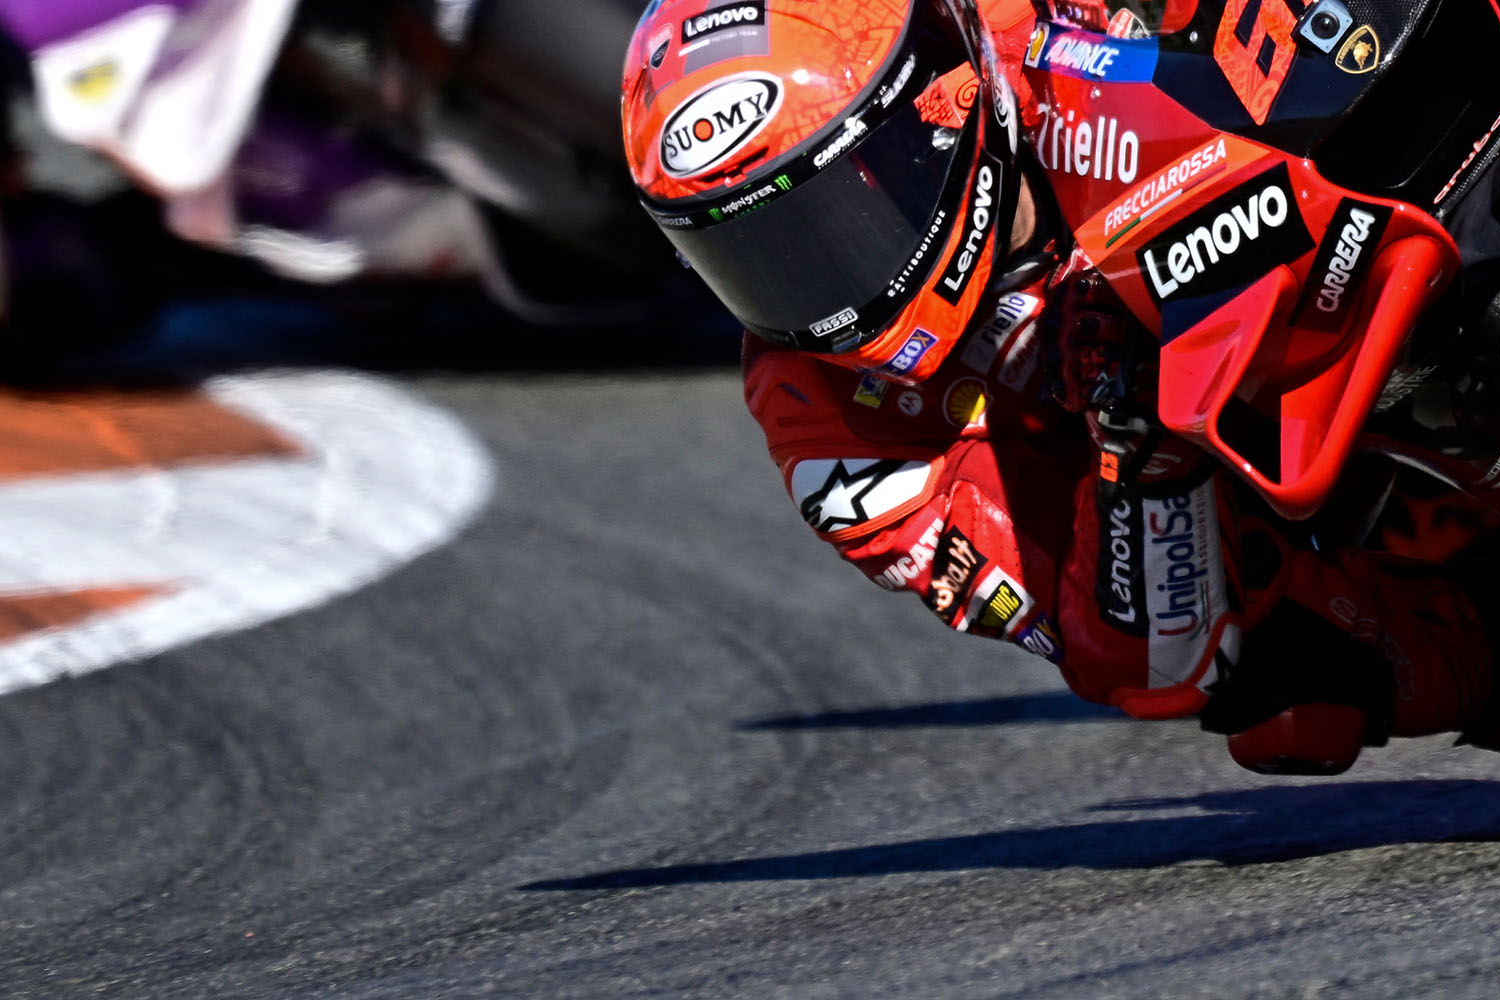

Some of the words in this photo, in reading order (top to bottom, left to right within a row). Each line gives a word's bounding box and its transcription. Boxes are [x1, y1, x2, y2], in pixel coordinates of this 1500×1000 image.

[684, 6, 758, 37] Lenovo
[1044, 36, 1120, 77] ADVANCE
[664, 92, 765, 158] SUOMY
[721, 184, 777, 214] MONSTER
[944, 165, 994, 292] Lenovo
[1104, 138, 1227, 237] FRECCIAROSSA
[1143, 184, 1289, 300] Lenovo
[1316, 206, 1377, 313] CARRERA
